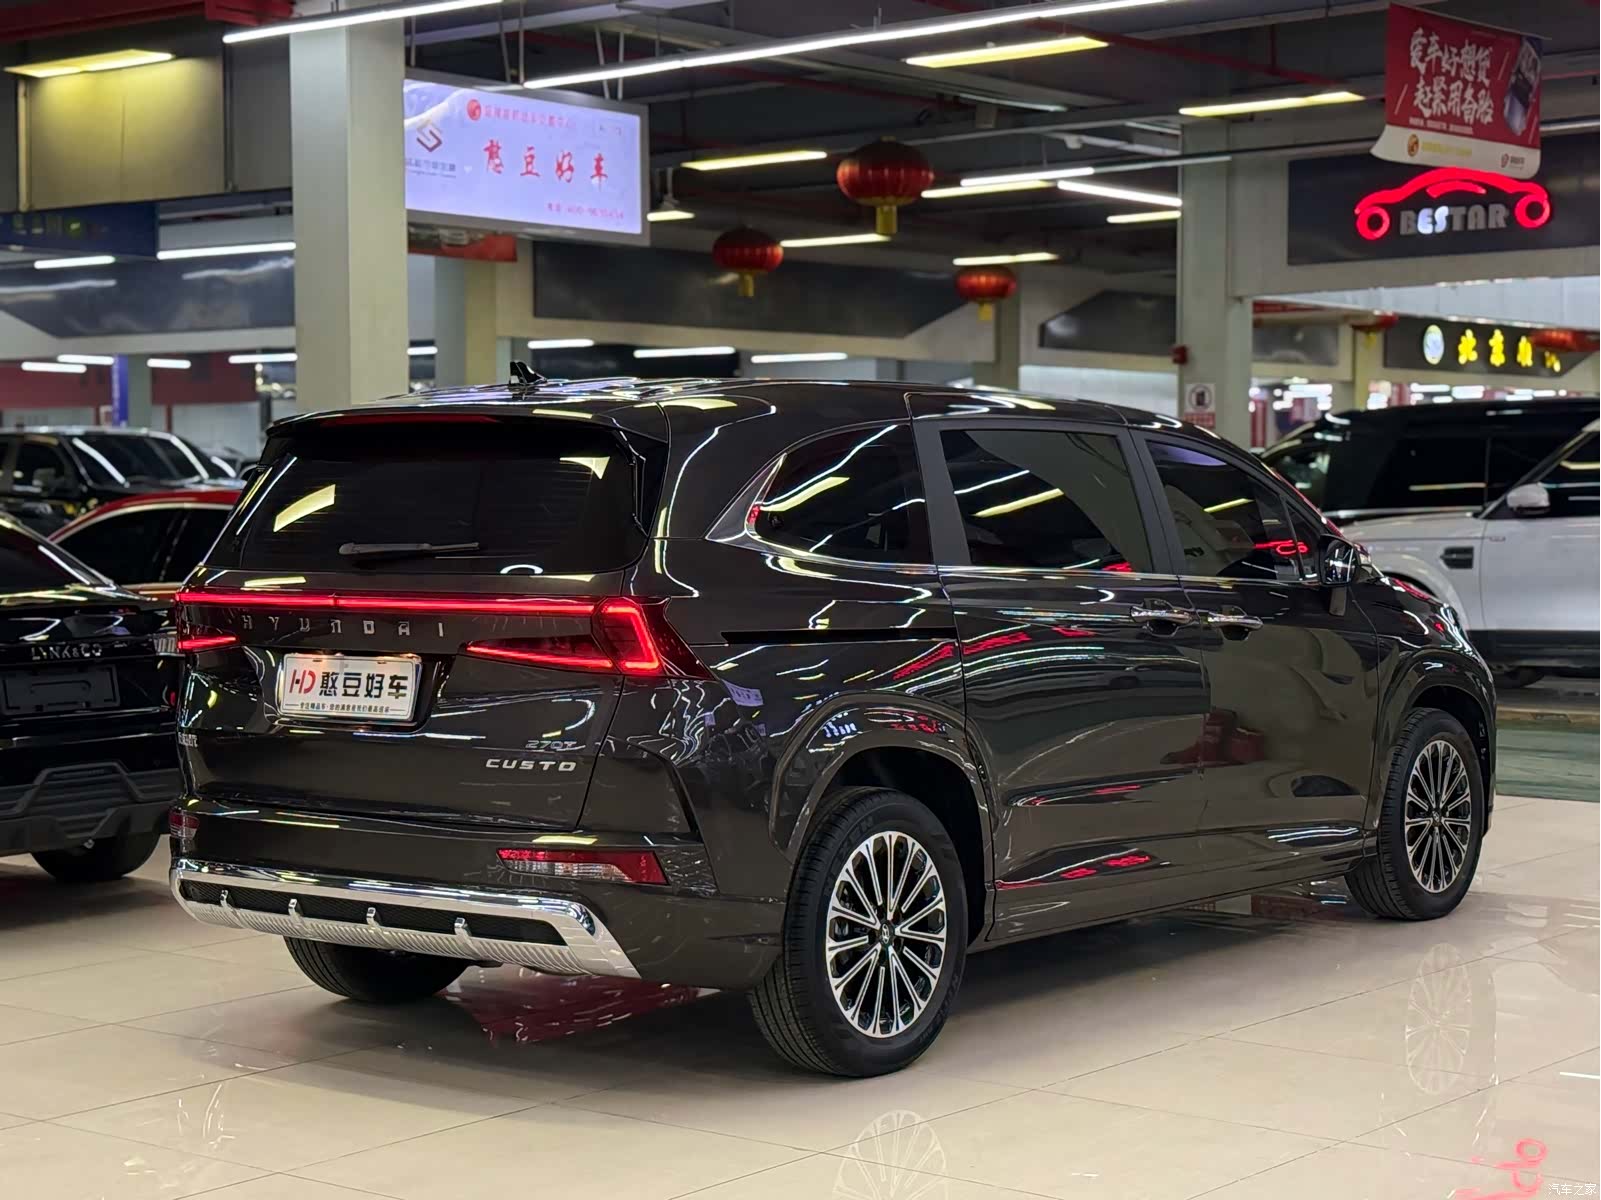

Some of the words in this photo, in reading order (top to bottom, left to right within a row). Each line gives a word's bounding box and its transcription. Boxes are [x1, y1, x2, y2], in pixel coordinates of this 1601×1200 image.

[1400, 203, 1509, 235] BESTAR
[242, 615, 445, 637] HYUNDAI
[31, 643, 102, 660] LYNK&CO
[319, 671, 408, 699] 憨豆好车
[525, 740, 577, 749] 270T
[486, 759, 577, 772] CUSTO
